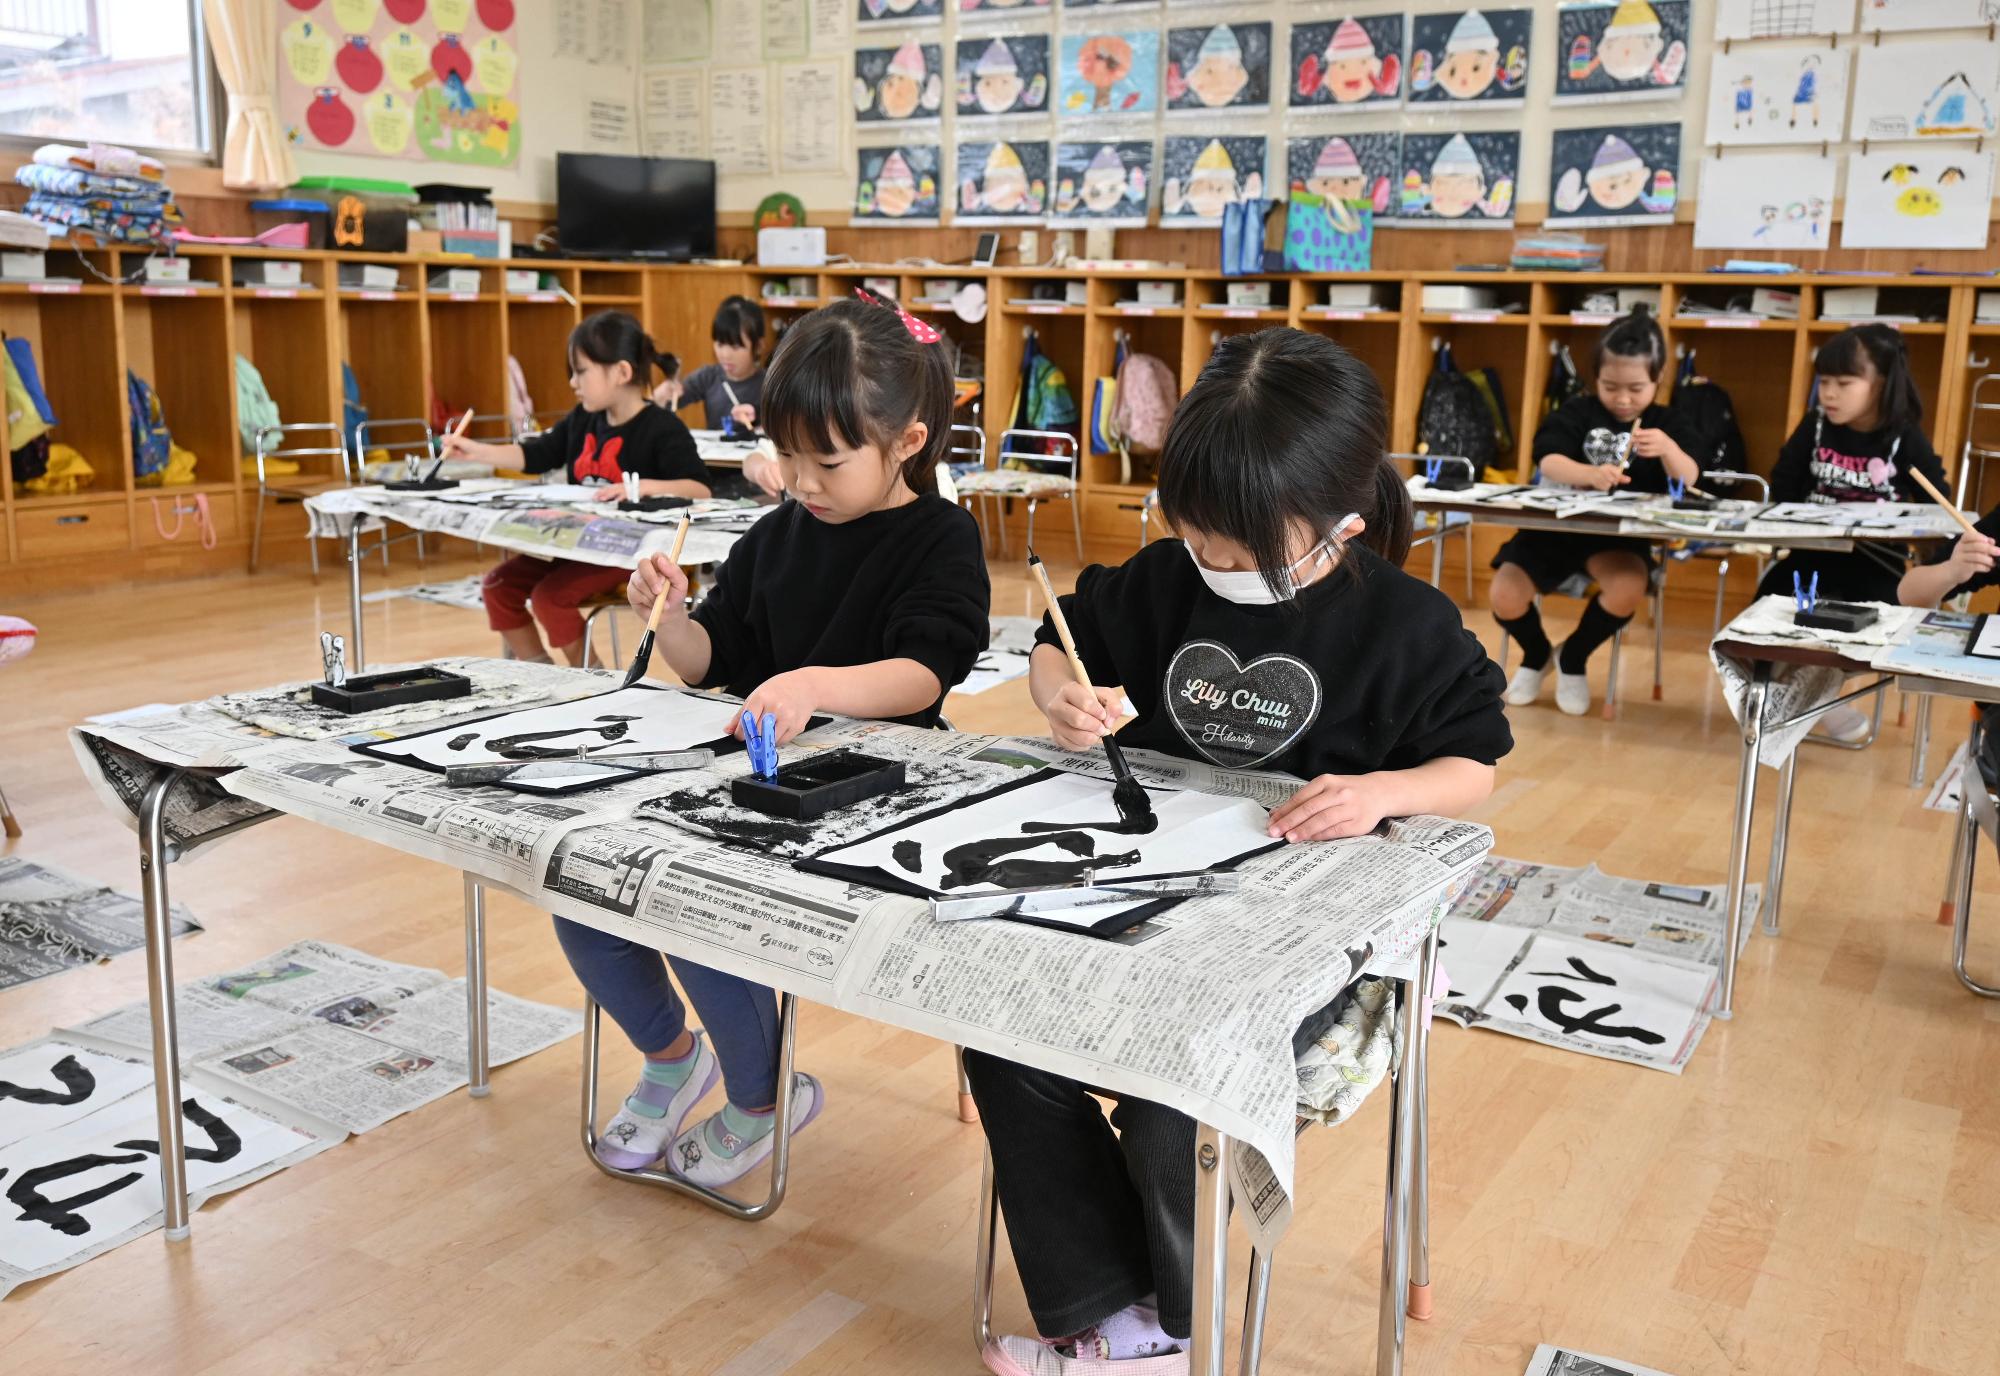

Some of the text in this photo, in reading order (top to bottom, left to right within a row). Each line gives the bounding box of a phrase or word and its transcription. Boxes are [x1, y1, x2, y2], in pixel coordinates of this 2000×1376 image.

[1181, 678, 1228, 710] Lily
[1256, 715, 1287, 730] mini
[1202, 723, 1256, 749] Hilarity
